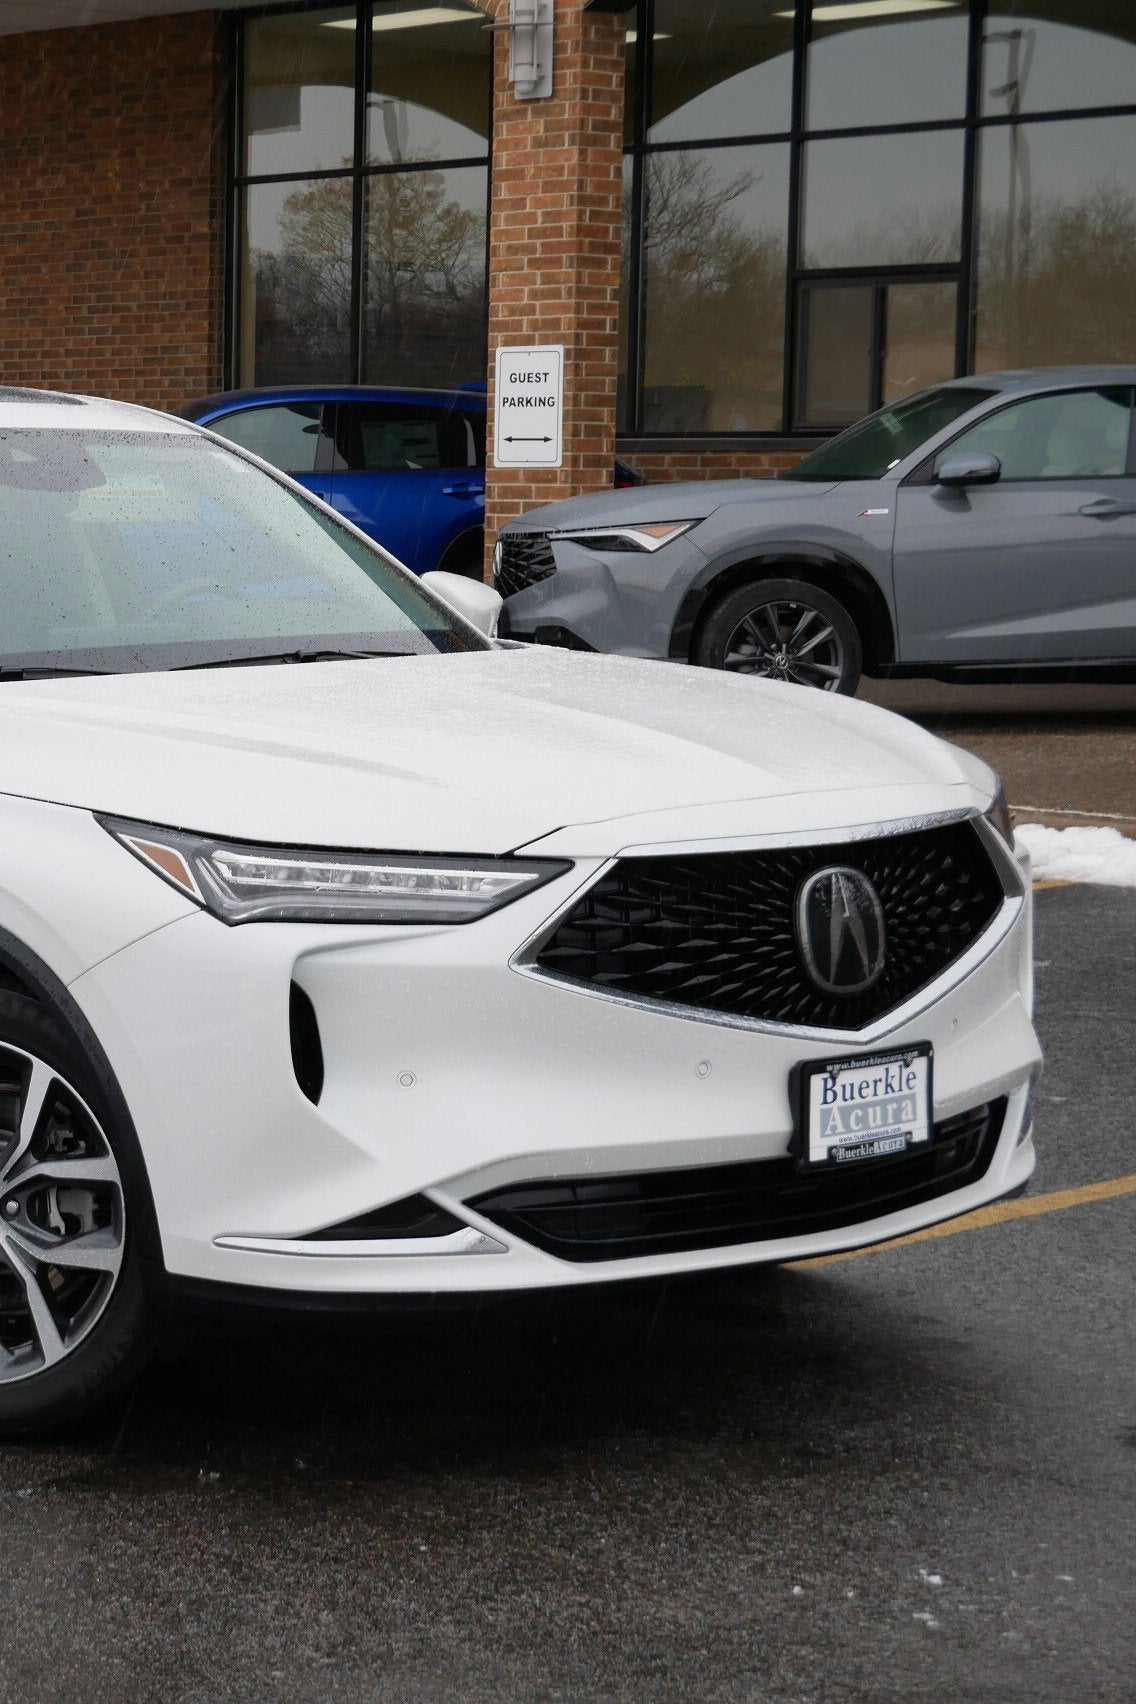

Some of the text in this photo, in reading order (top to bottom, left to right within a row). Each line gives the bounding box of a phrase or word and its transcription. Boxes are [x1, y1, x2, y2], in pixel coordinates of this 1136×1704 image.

[509, 372, 550, 383] GUEST
[502, 396, 556, 408] PARKING
[820, 1064, 917, 1106] Buerkle
[824, 1100, 914, 1135] Acura
